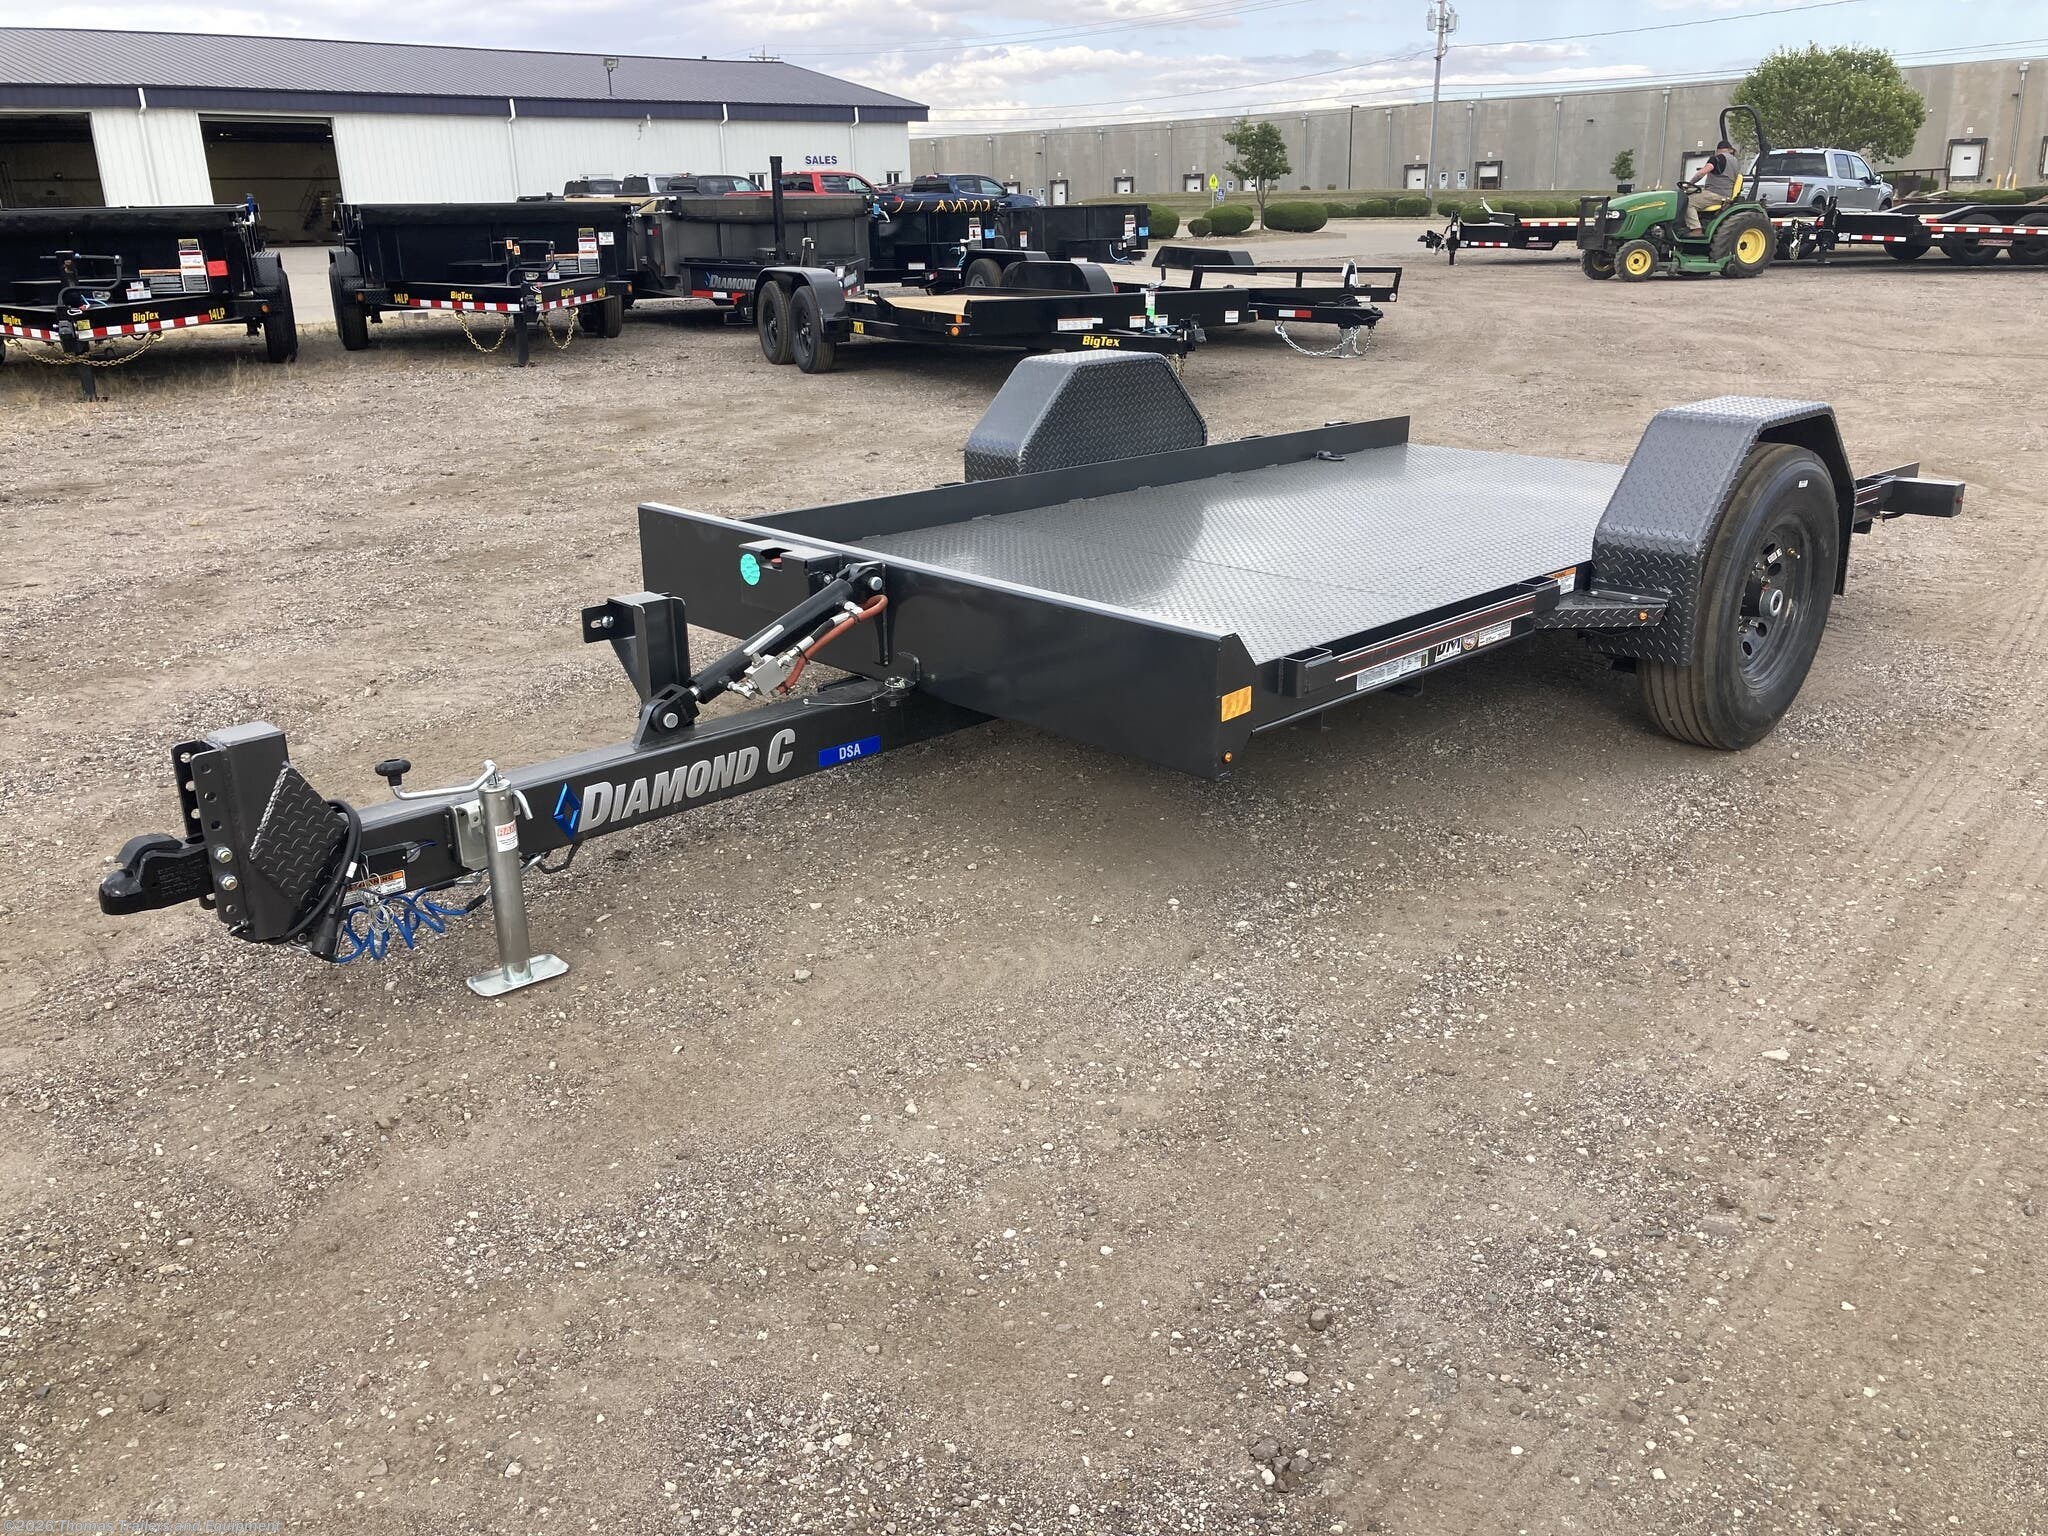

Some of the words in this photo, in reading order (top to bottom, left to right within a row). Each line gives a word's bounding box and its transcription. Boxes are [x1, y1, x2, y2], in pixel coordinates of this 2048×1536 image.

[805, 155, 838, 165] SALES
[709, 274, 758, 291] DIAMOND
[450, 290, 474, 302] BigTex
[132, 311, 160, 323] BigTex
[208, 307, 226, 321] 14LP
[1082, 334, 1121, 349] BigTex
[838, 743, 862, 761] DSA
[577, 745, 760, 833] DIAMOND
[766, 727, 797, 775] C
